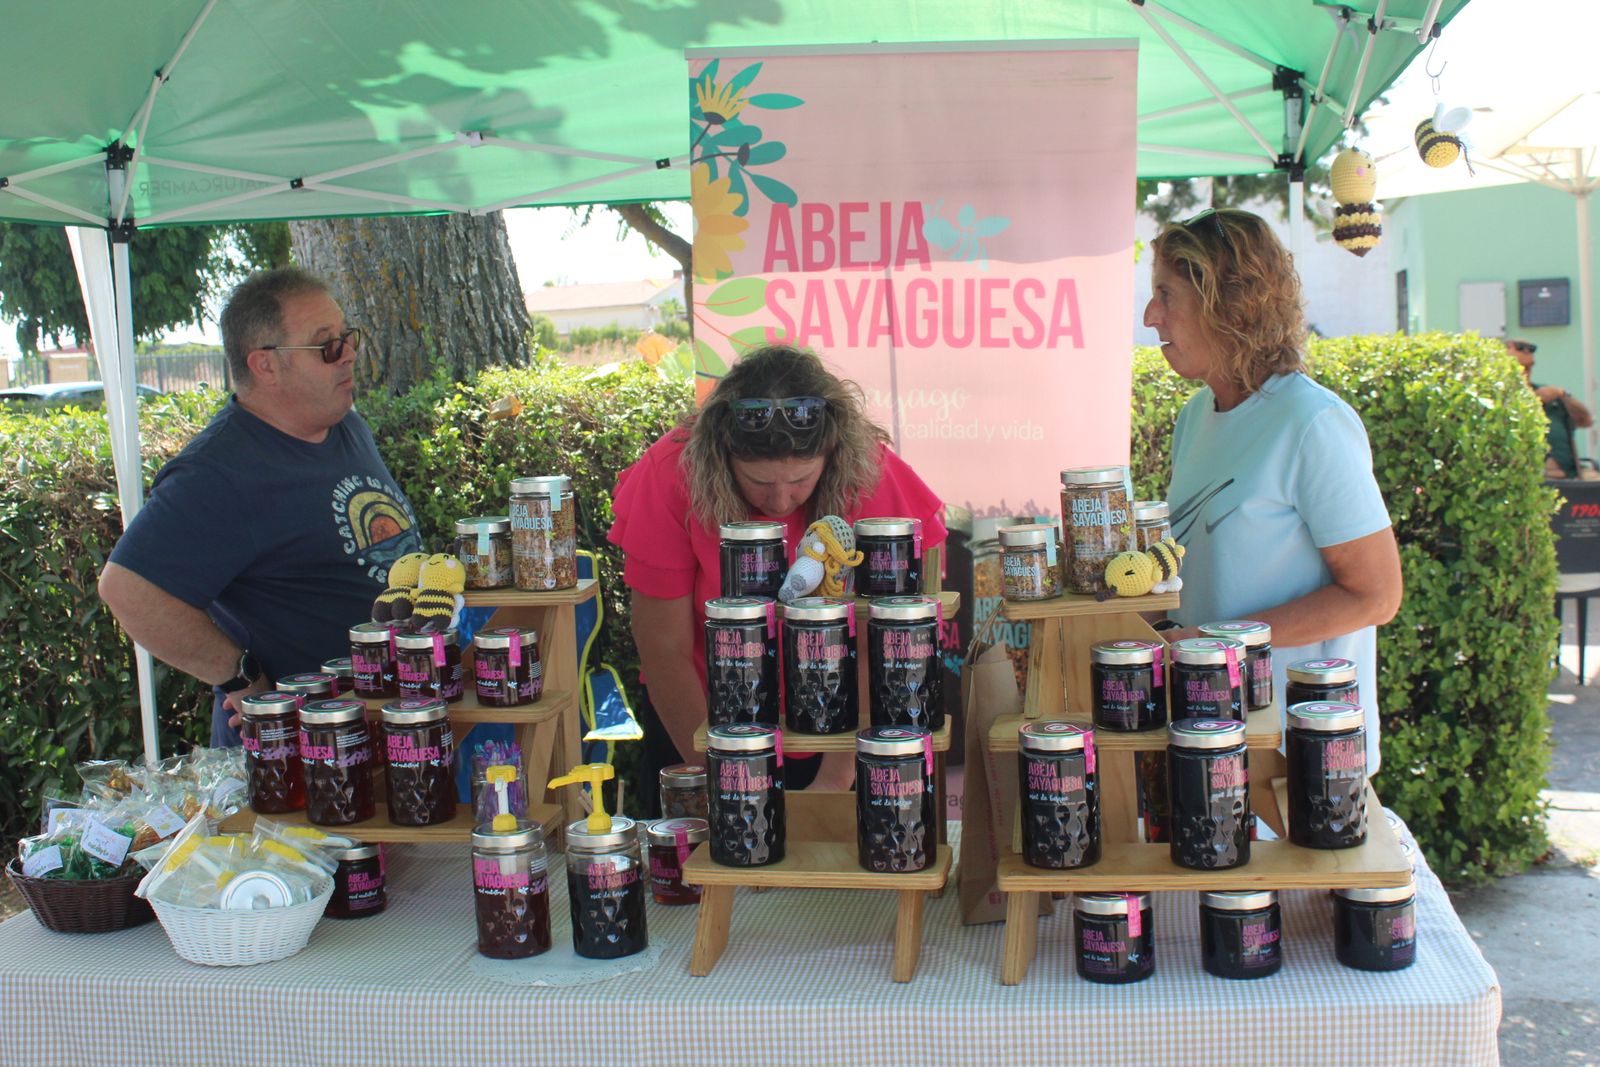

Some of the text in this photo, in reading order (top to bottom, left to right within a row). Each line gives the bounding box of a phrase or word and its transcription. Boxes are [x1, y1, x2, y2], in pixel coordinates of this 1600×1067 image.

[763, 202, 932, 273] ABEJA
[764, 278, 1086, 350] SAYAGUESA
[865, 386, 972, 428] ayago
[904, 418, 979, 440] calidad
[984, 424, 995, 443] y
[1001, 419, 1045, 441] vida
[1072, 498, 1103, 512] ABEJA
[1073, 509, 1128, 526] SAYAGUESA
[715, 630, 742, 644] ABEJA
[883, 631, 911, 645] ABEJA
[715, 642, 766, 658] SAYAGUESA
[883, 643, 934, 659] SAYAGUESA
[1103, 680, 1124, 691] ABEJA
[1186, 680, 1210, 692] ABEJA
[1103, 689, 1145, 701] SAYAGUESA
[1186, 690, 1230, 702] SAYAGUESA
[387, 735, 414, 748] ABEJA
[1326, 741, 1355, 755] ABEJA
[388, 746, 440, 762] SAYAGUESA
[721, 760, 749, 777] ABEJA
[870, 768, 900, 782] ABEJA
[1028, 762, 1056, 777] ABEJA
[720, 775, 773, 792] SAYAGUESA
[871, 779, 925, 797] SAYAGUESA
[1028, 776, 1083, 792] SAYAGUESA
[588, 862, 615, 876] ABEJA
[348, 872, 369, 883] ABEJA
[588, 869, 638, 890] SAYAGUESA
[1082, 929, 1104, 942] ABEJA
[1243, 924, 1265, 936] ABEJA
[1083, 940, 1126, 952] SAYAGUESA
